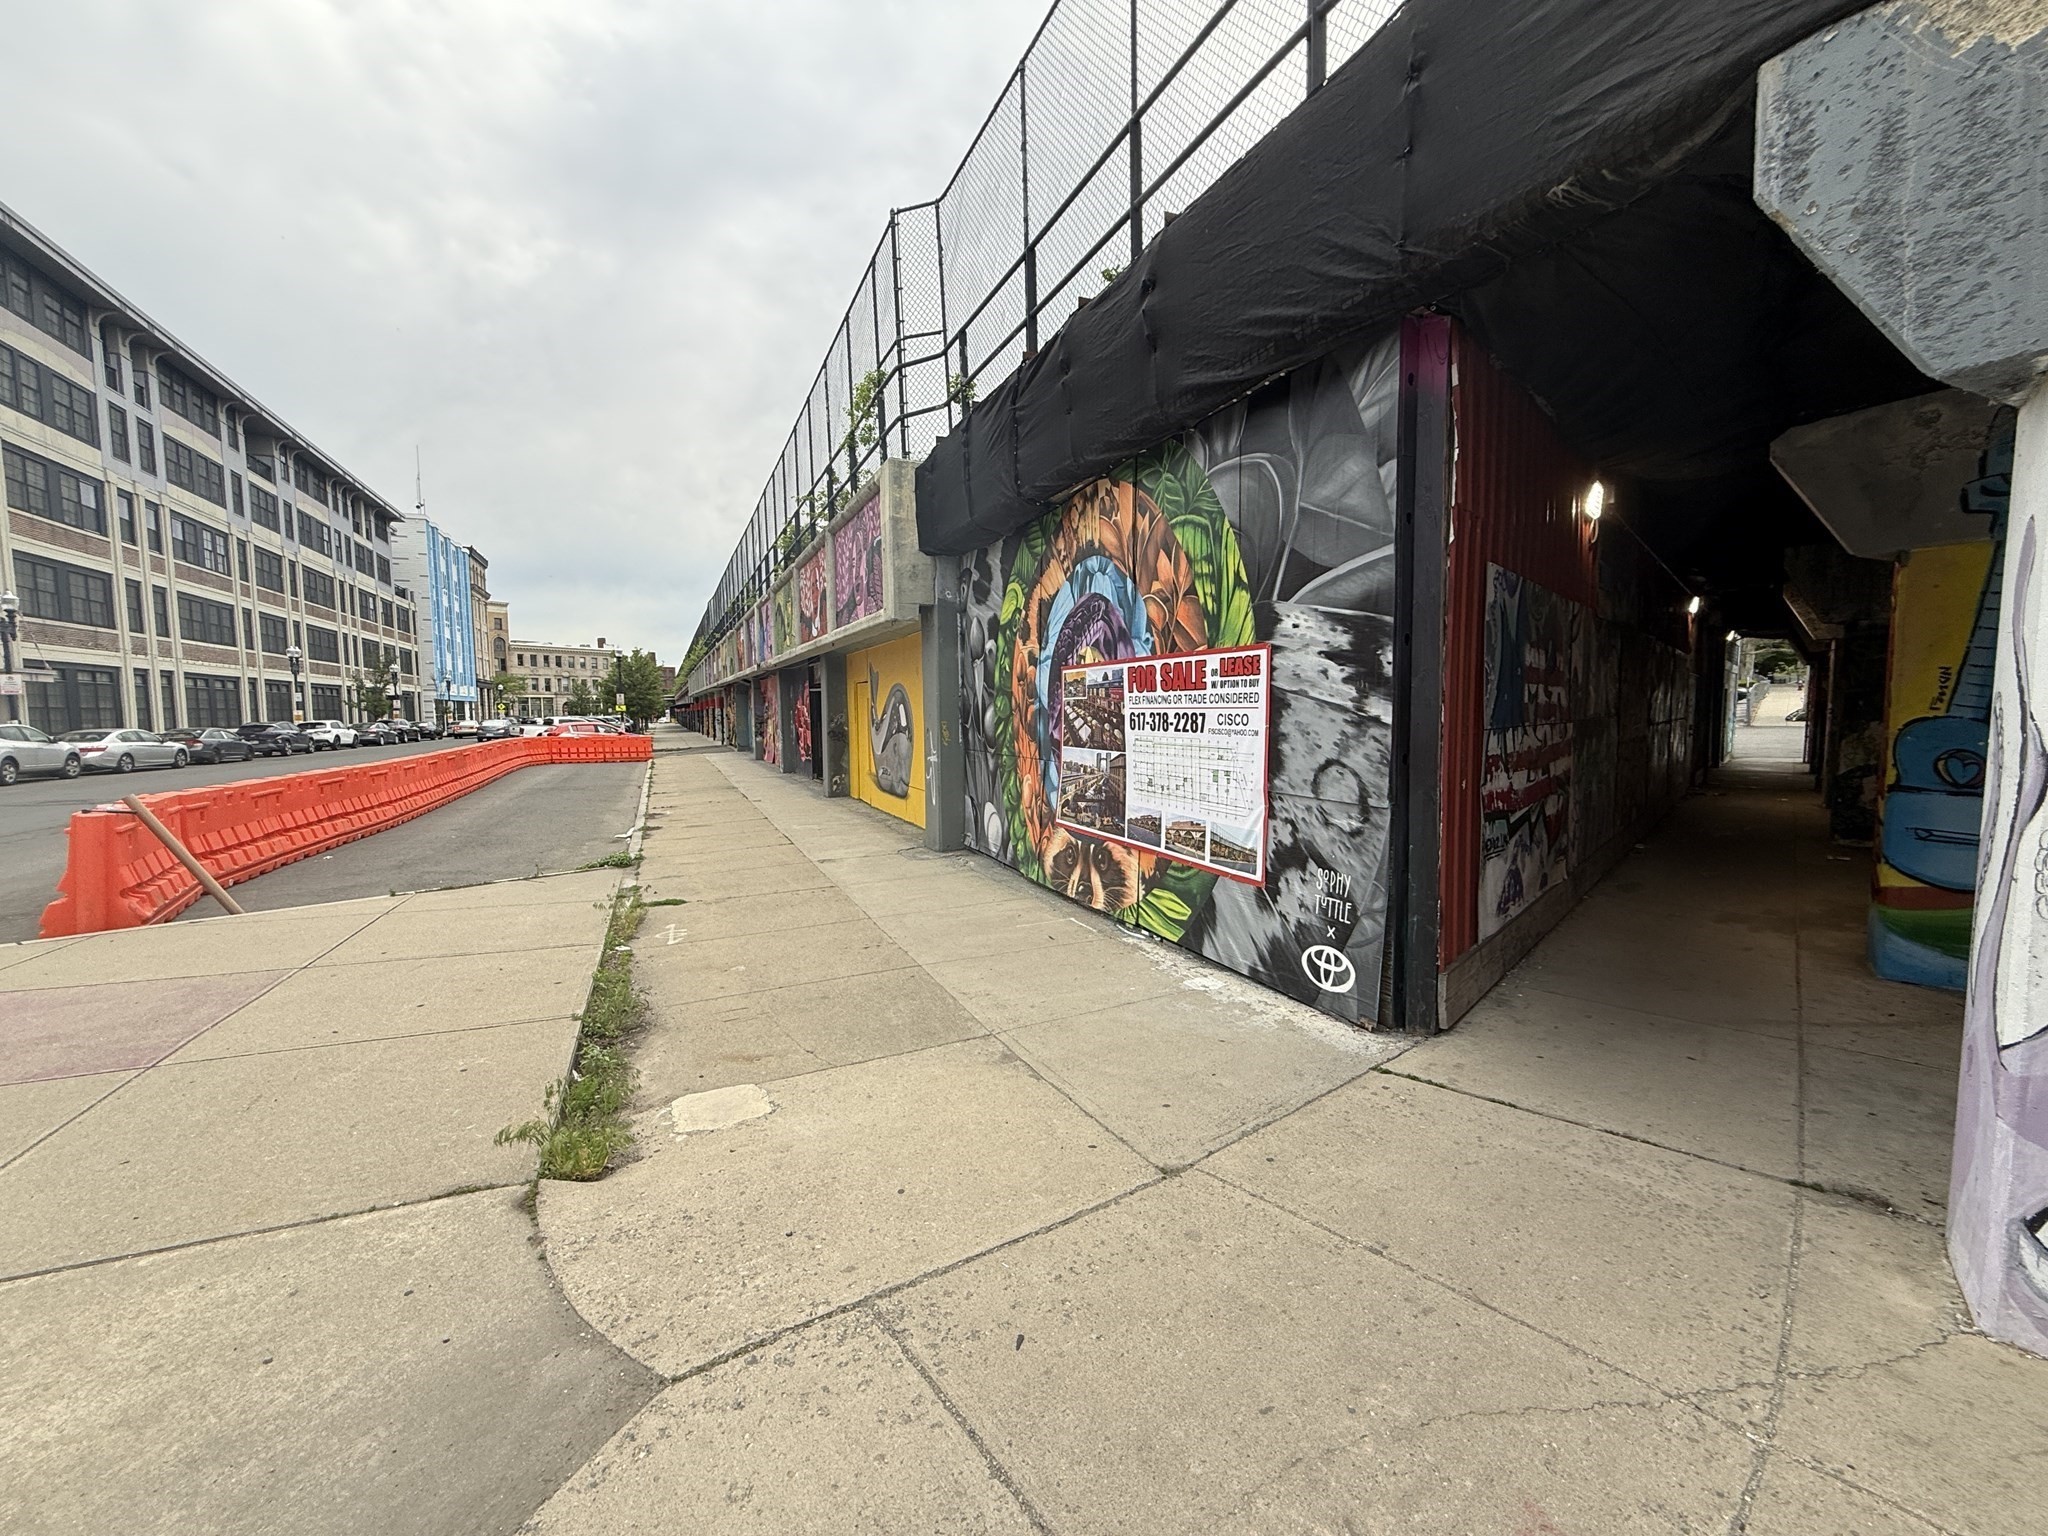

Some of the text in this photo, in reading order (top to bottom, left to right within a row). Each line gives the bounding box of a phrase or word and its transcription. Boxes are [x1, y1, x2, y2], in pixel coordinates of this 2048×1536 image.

[1127, 660, 1207, 693] FOR SALE
[1211, 655, 1261, 677] OR LEASE
[1211, 678, 1260, 689] W/ OPTION TO BUY
[1129, 692, 1260, 705] FLEX FINANCING OR TRADE CONSIDERED
[1129, 711, 1249, 734] 617-378-2287 CISCO
[1316, 867, 1351, 898] SOPHY
[1315, 894, 1352, 924] TUTTLE
